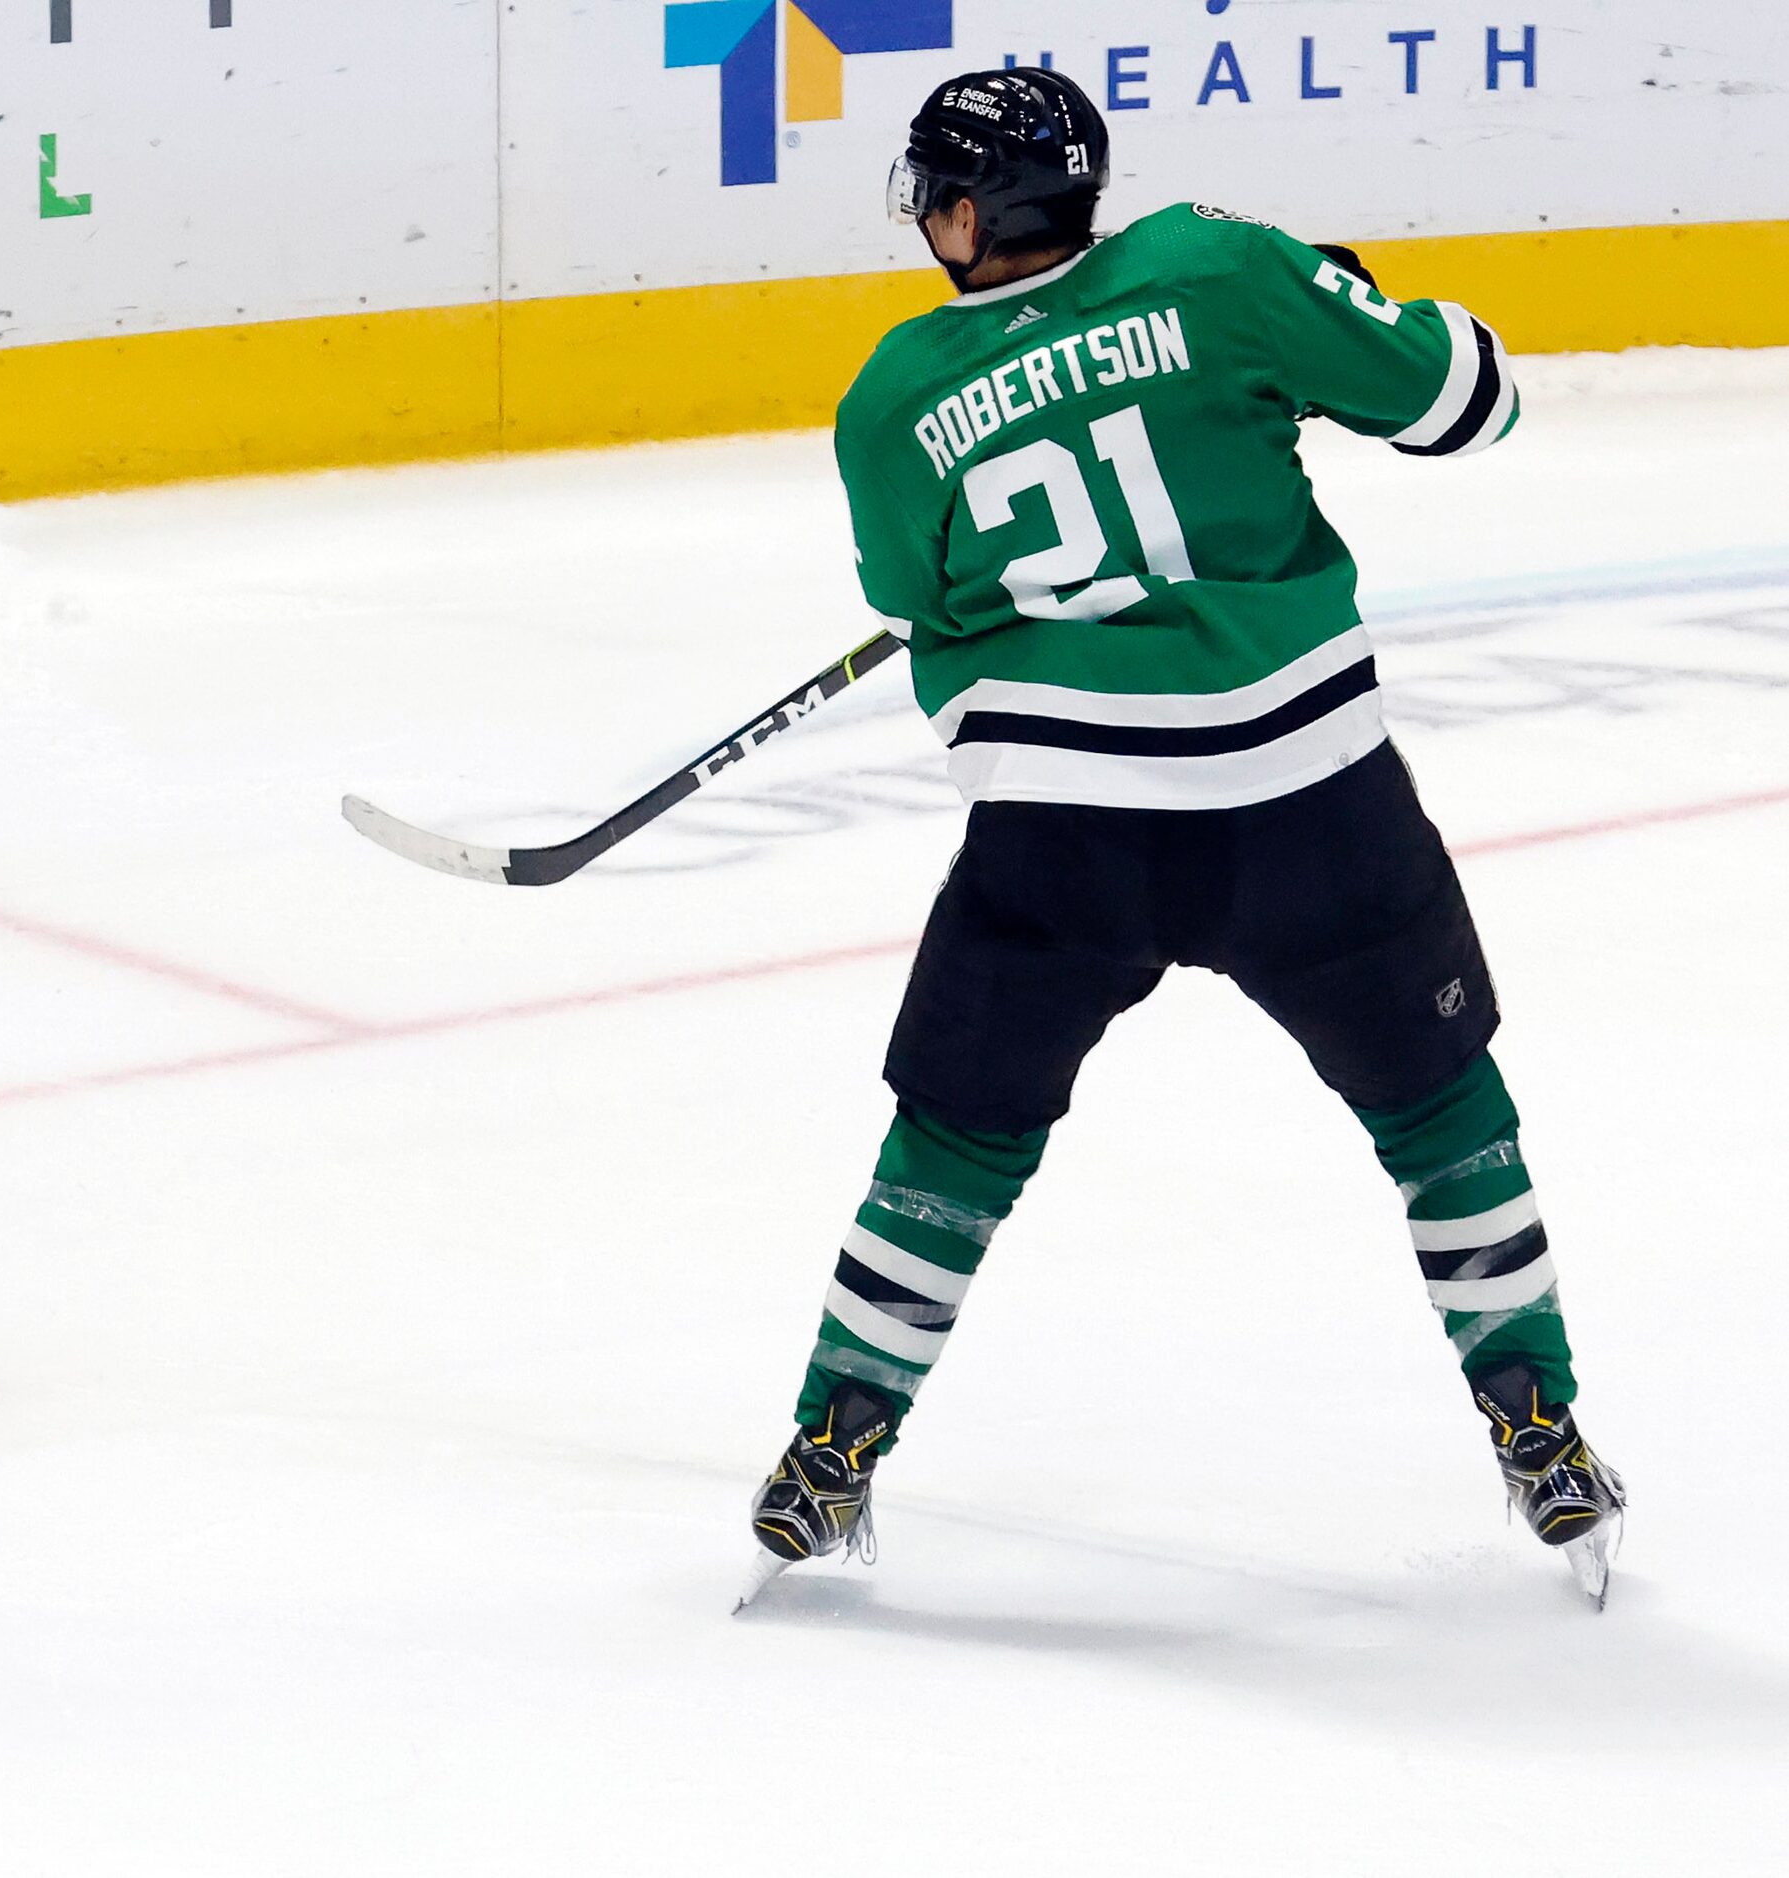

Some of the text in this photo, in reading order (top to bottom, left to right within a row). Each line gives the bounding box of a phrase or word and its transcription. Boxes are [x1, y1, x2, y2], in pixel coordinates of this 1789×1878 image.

[956, 98, 1003, 122] TRANSFER
[960, 87, 999, 107] ENERGY
[1004, 24, 1537, 111] EALTH
[1064, 143, 1089, 175] 21
[914, 306, 1191, 480] ROBERTSON
[962, 404, 1197, 623] 21
[688, 683, 827, 786] CCM
